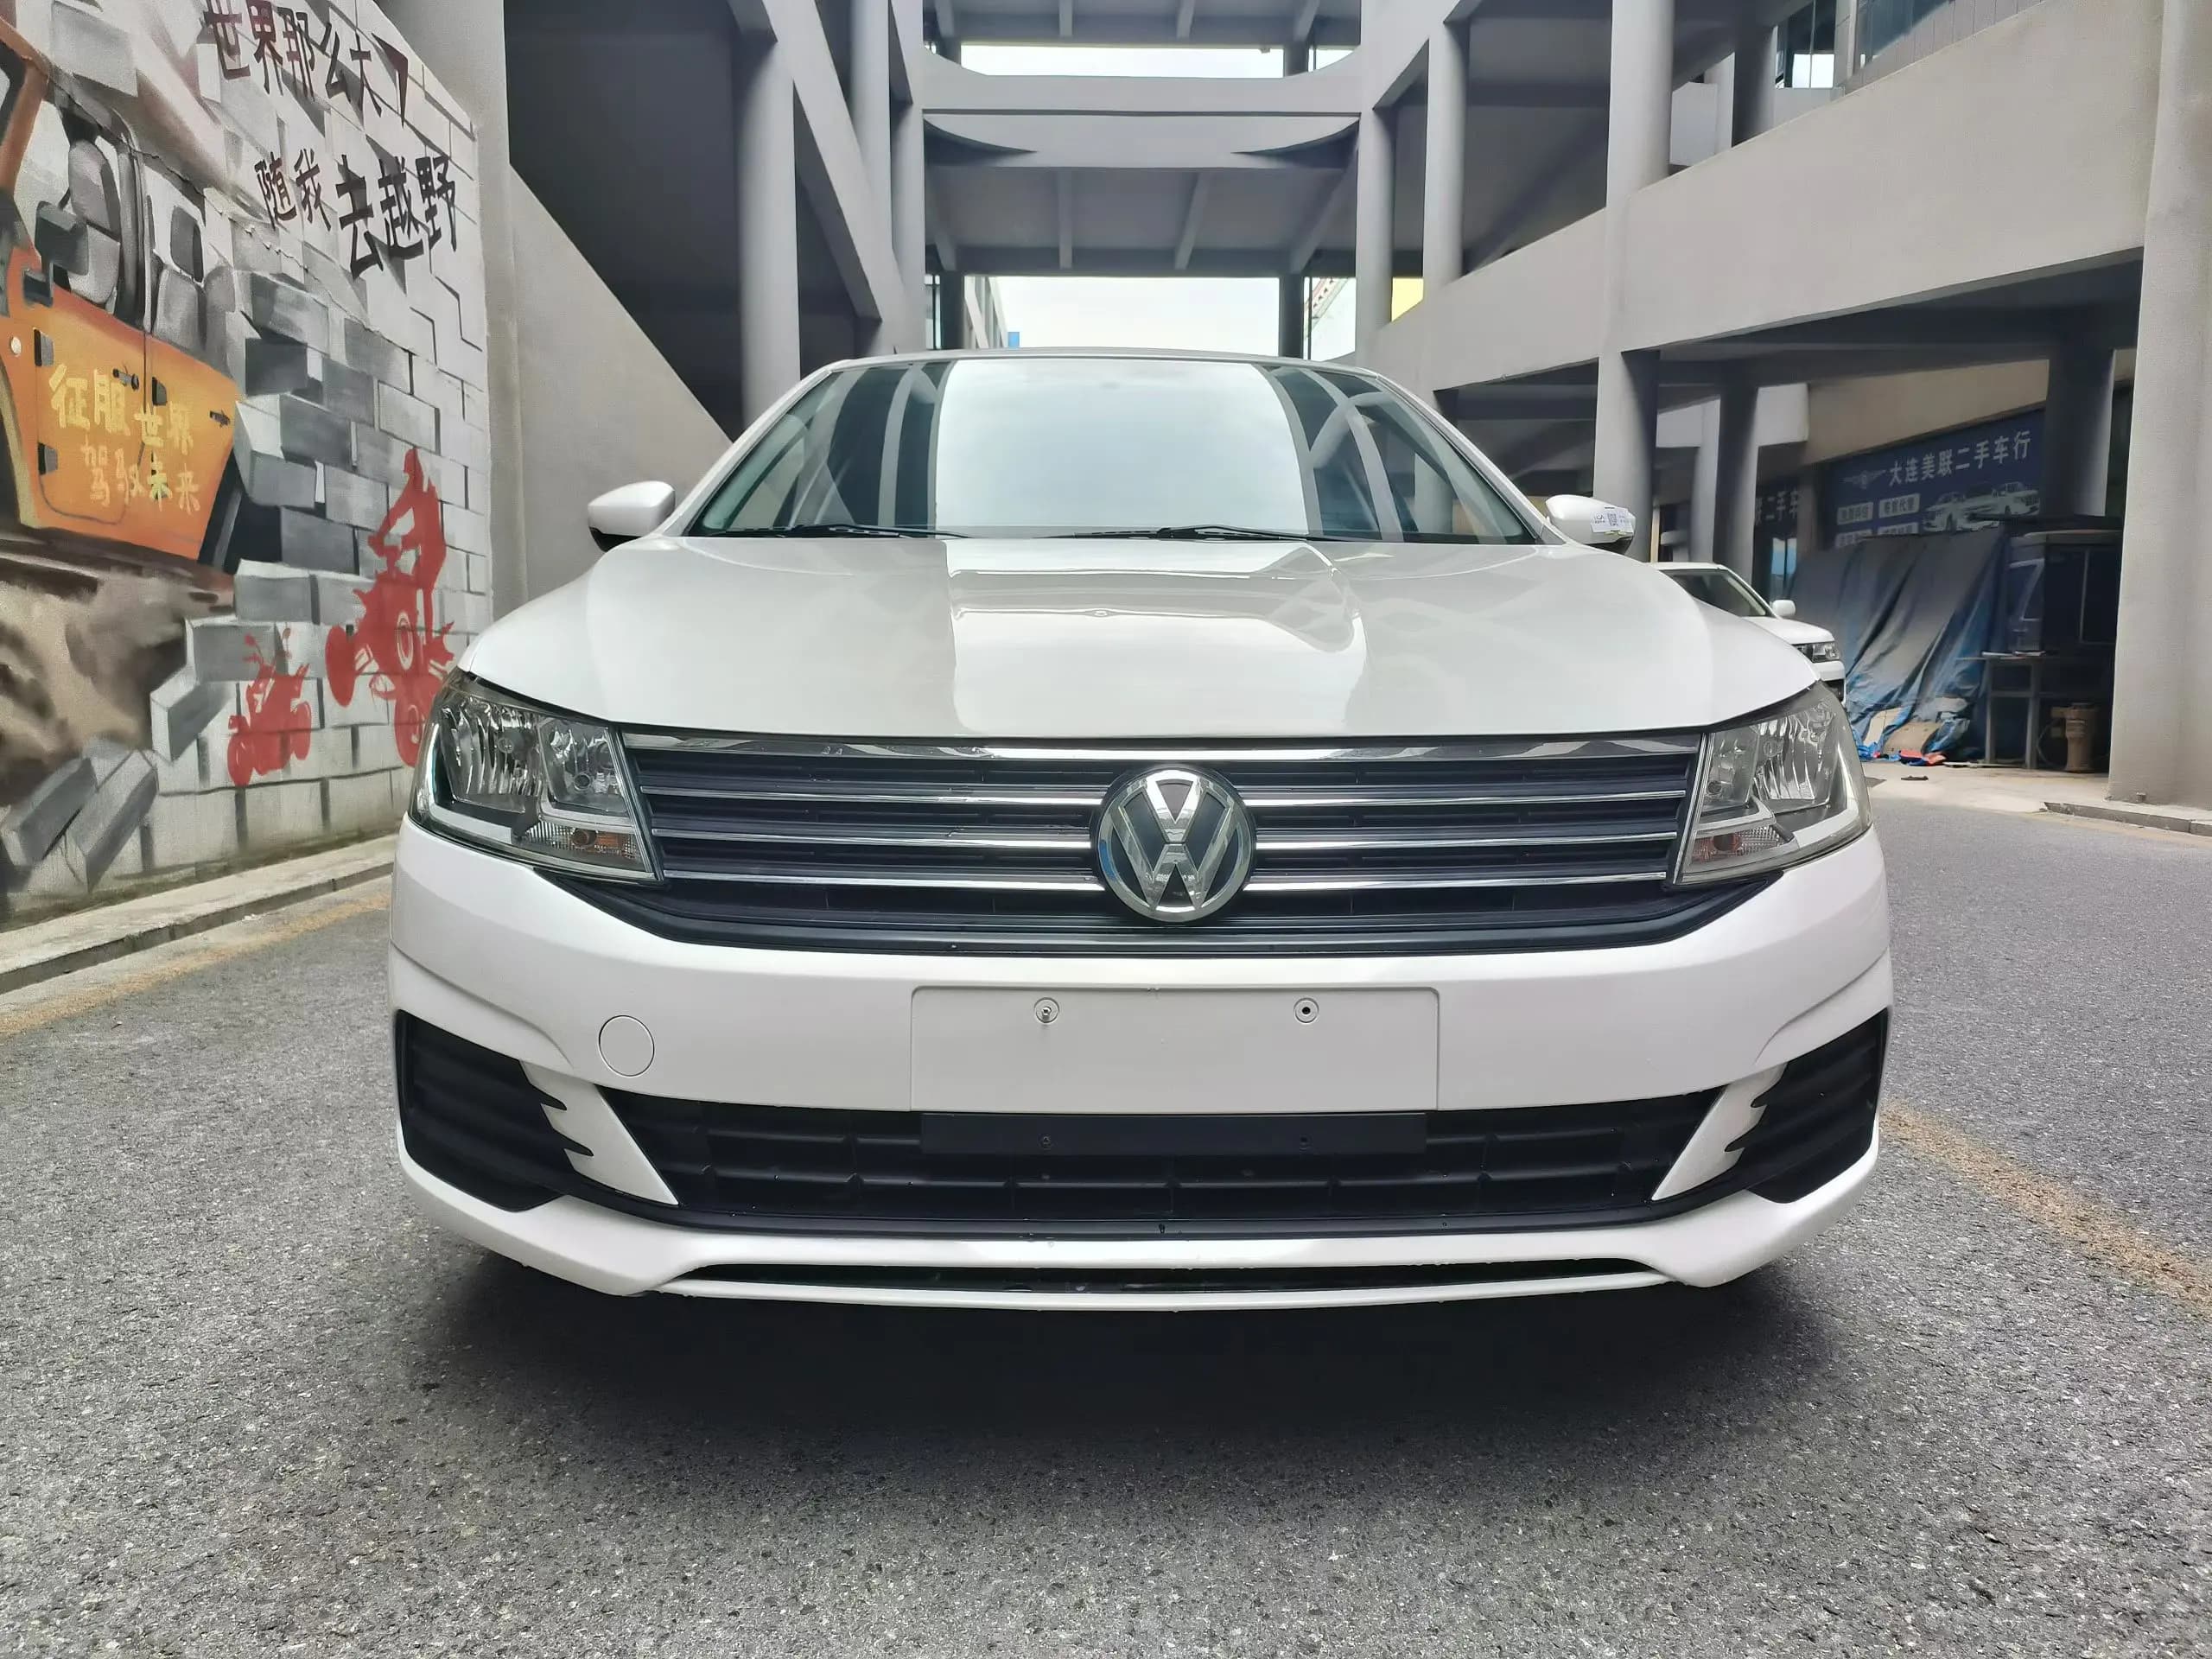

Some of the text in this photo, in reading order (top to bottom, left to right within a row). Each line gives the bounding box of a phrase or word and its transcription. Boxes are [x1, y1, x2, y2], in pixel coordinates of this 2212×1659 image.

[254, 149, 456, 281] 随我去越野
[1889, 430, 2031, 487] 大连美联二手车行
